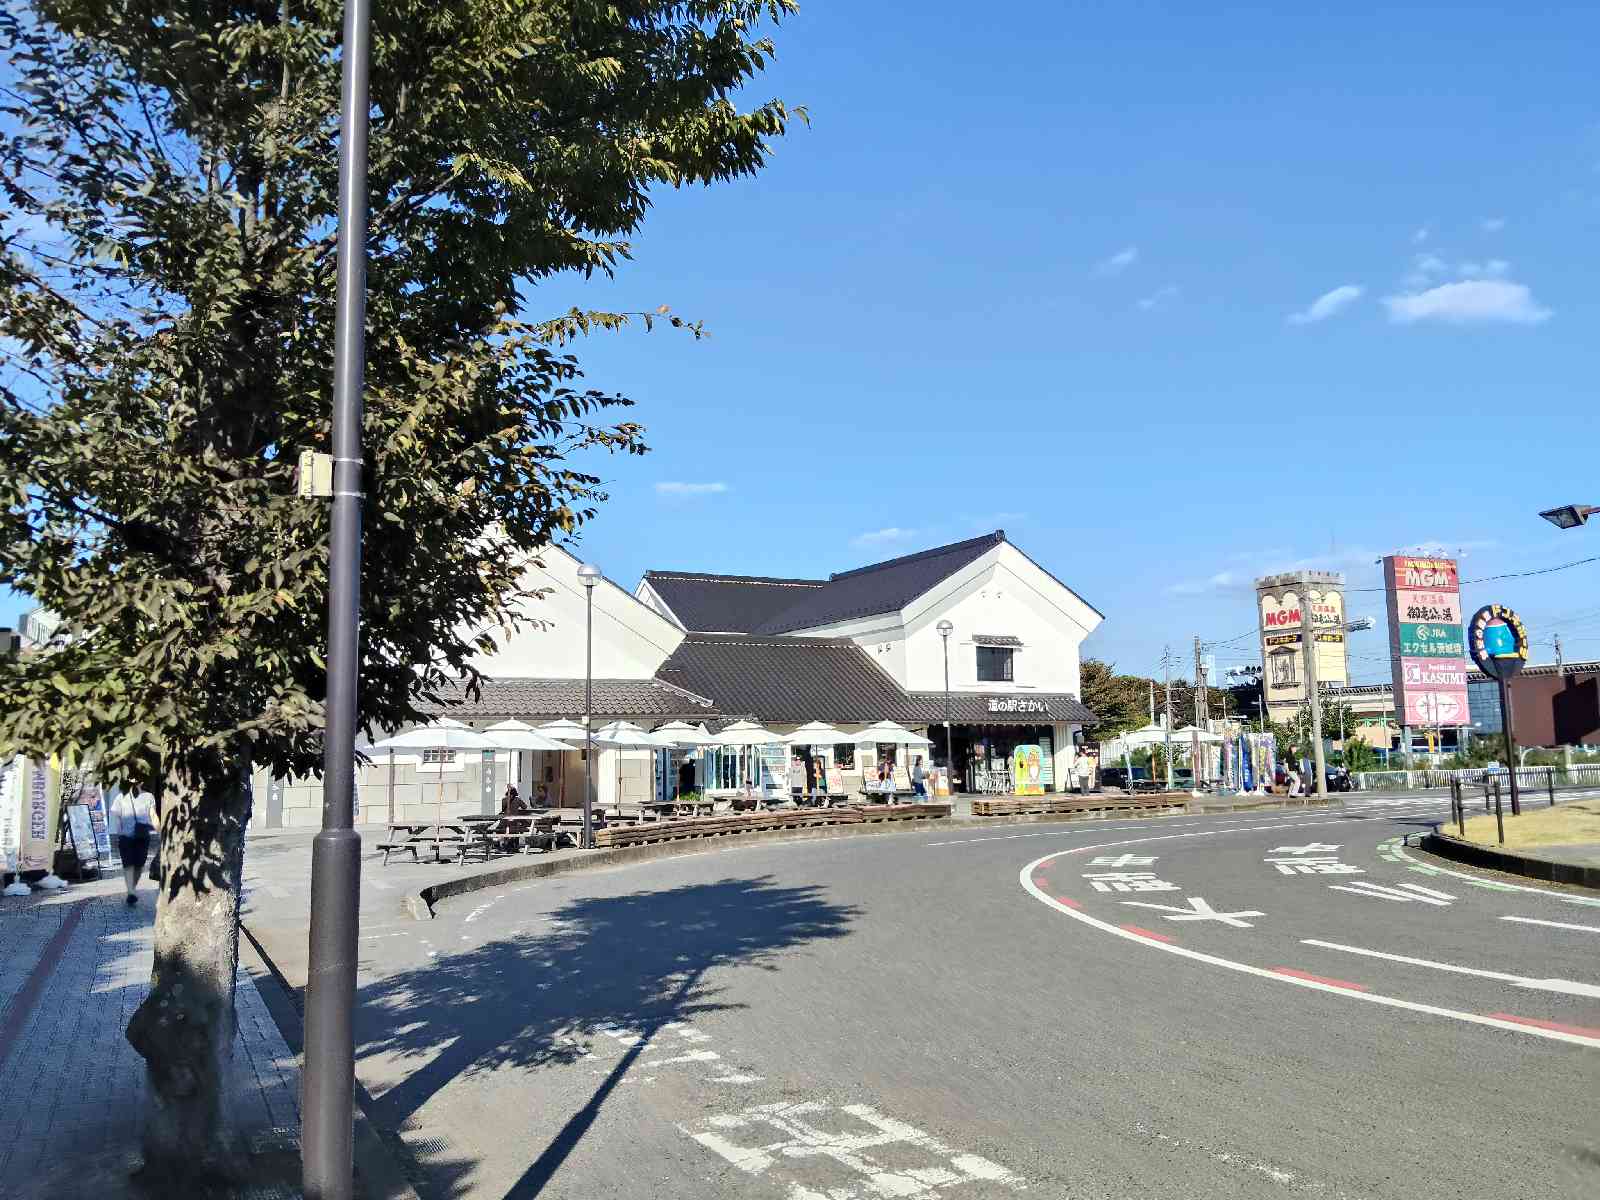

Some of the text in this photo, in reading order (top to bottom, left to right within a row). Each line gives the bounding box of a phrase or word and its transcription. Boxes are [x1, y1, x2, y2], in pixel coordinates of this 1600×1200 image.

[1405, 569, 1449, 587] MGM
[1265, 609, 1302, 626] MGM
[1431, 628, 1447, 638] JRA
[1422, 671, 1465, 685] KASUMI
[988, 698, 1049, 712] 道の駅さかい
